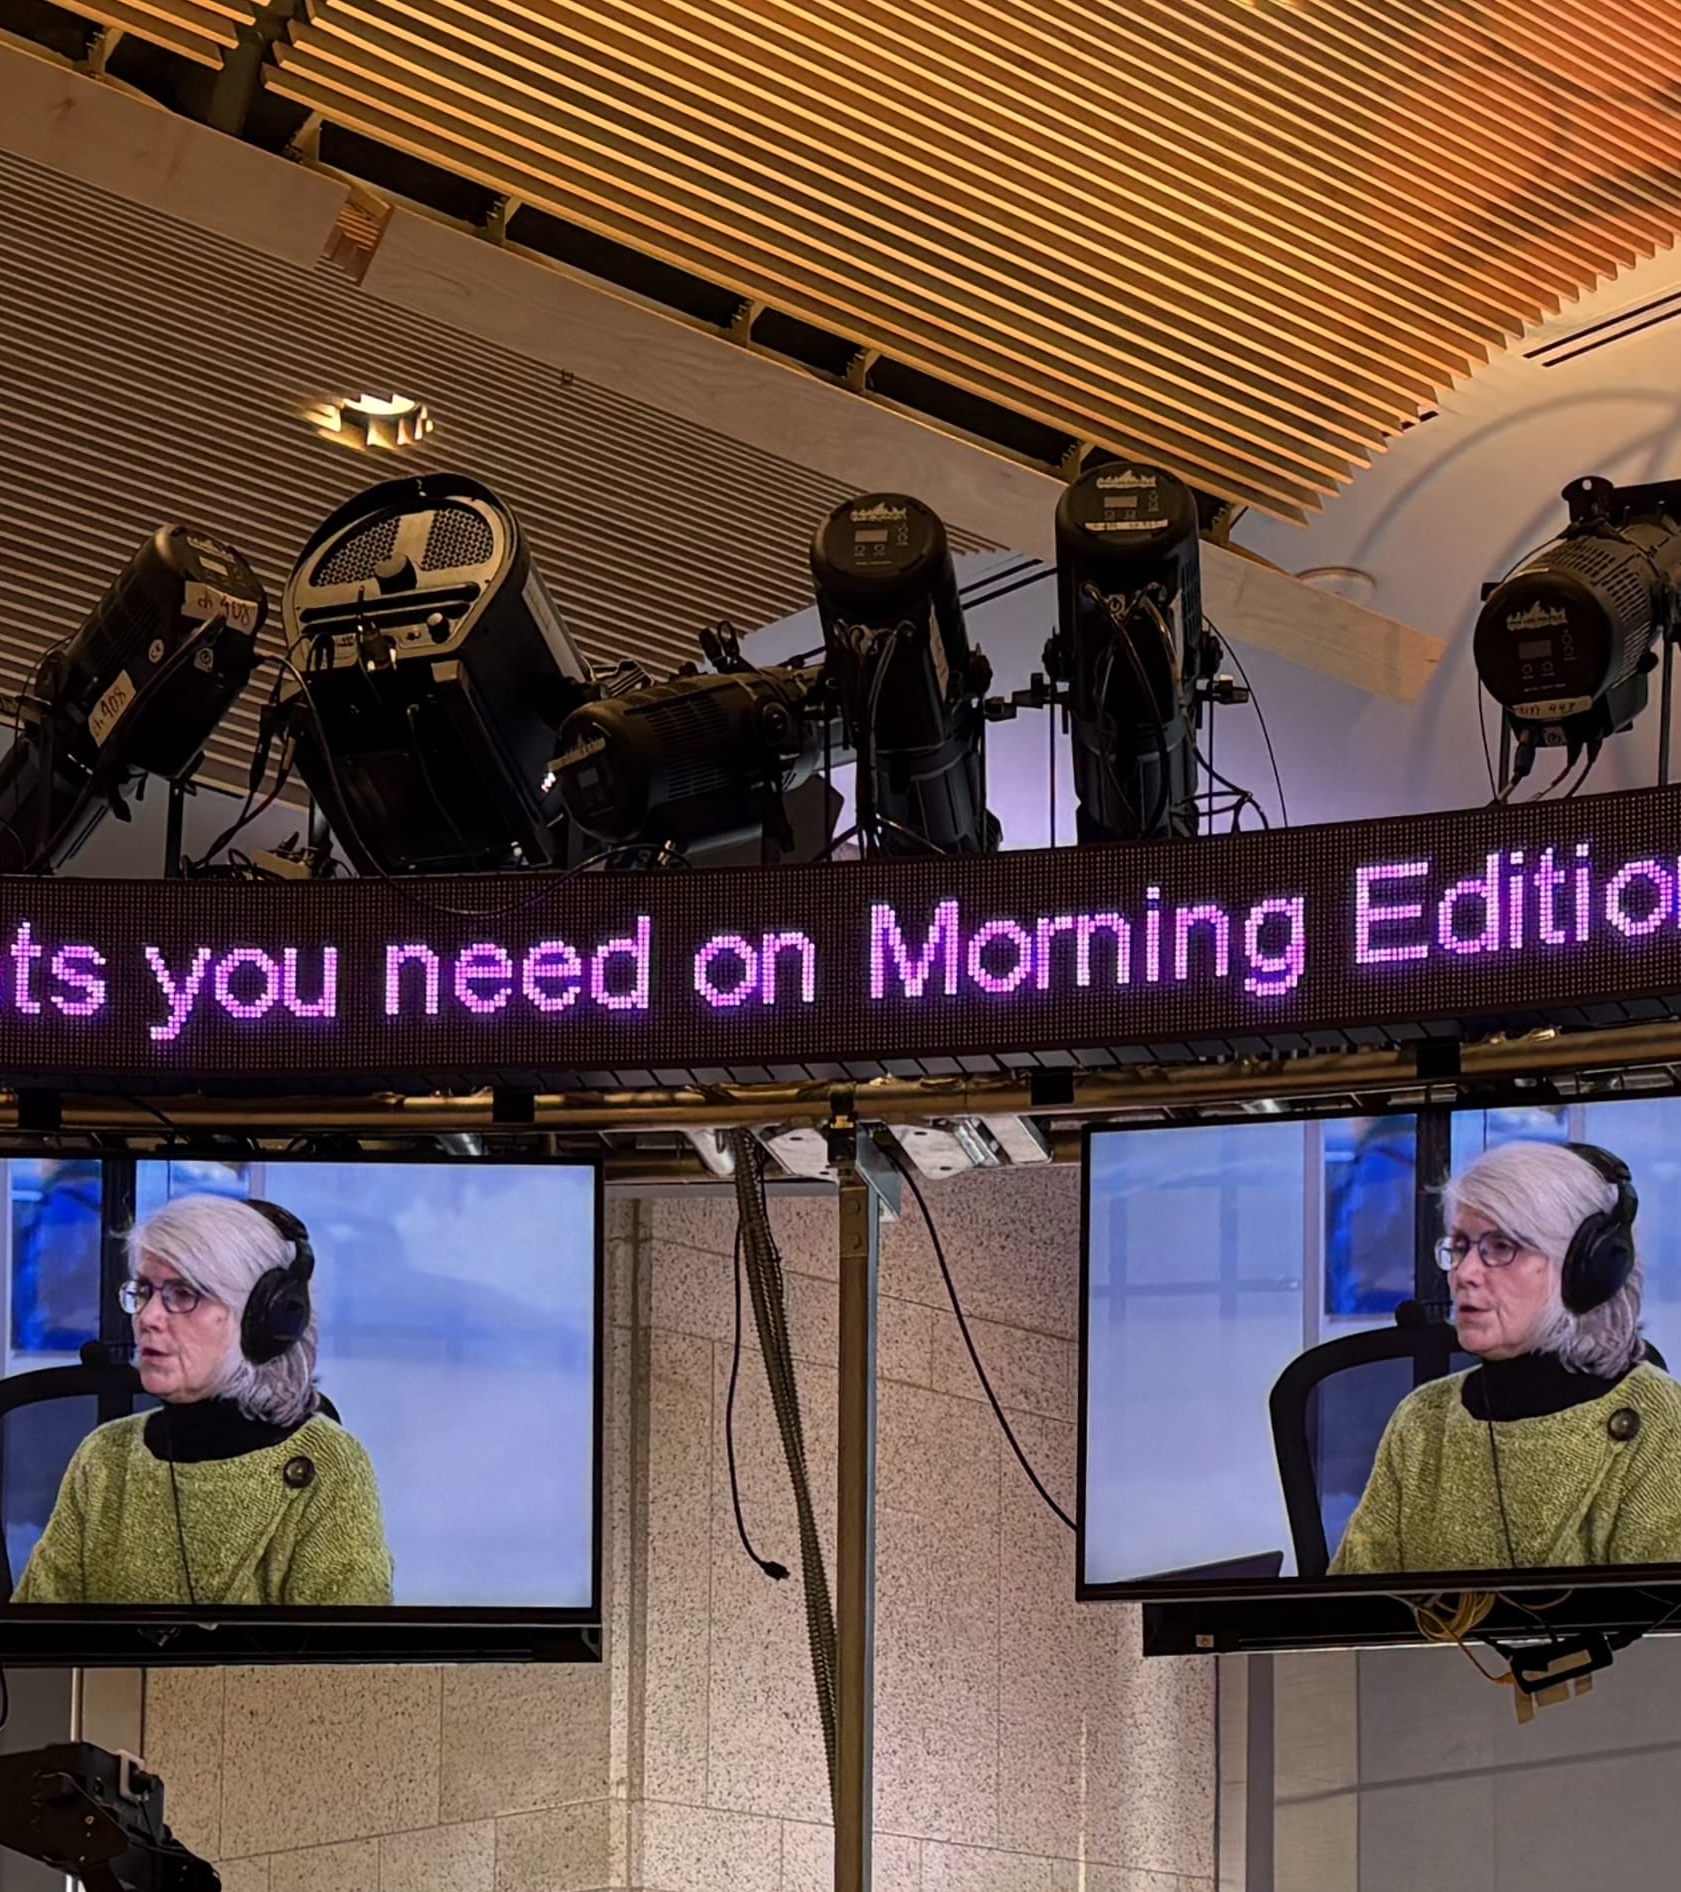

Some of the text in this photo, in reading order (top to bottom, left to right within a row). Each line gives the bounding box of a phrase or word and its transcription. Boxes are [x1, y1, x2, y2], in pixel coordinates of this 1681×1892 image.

[147, 946, 337, 1041] you
[385, 916, 650, 1015] need
[693, 931, 816, 1006] on
[870, 887, 1305, 998] Morning
